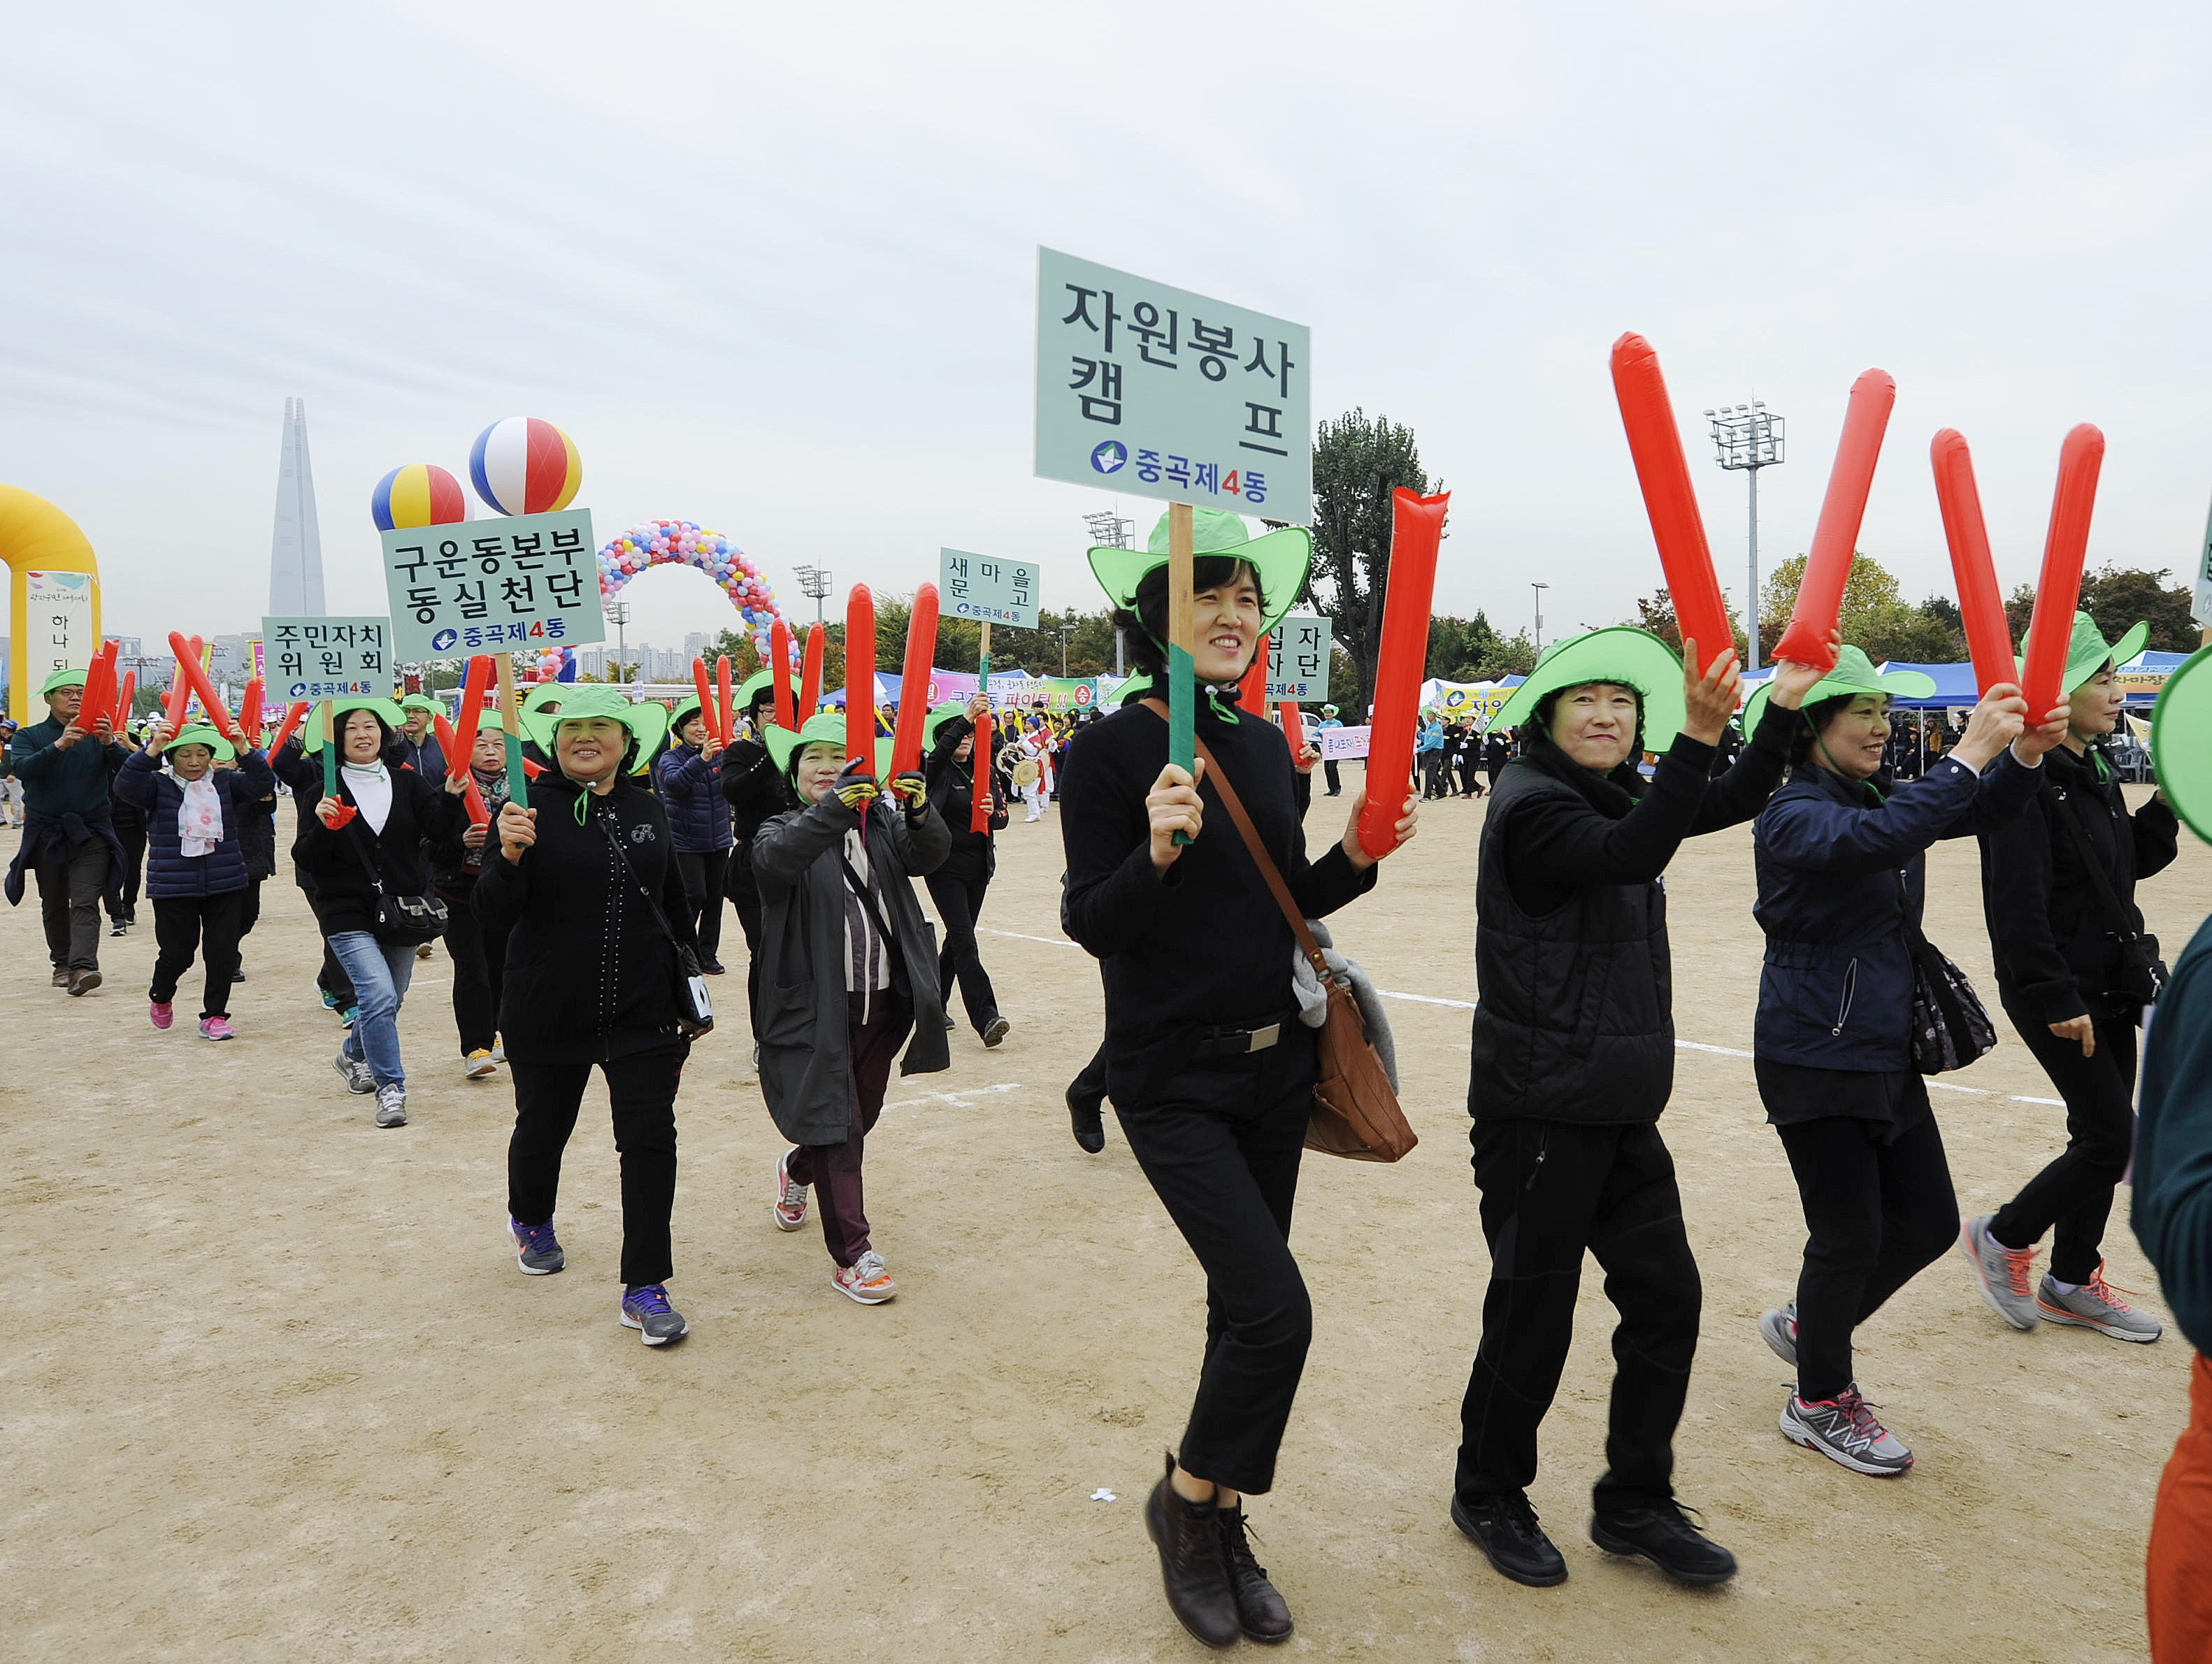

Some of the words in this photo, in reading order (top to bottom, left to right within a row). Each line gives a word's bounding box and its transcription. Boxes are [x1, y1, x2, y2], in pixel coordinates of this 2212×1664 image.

[1062, 283, 1294, 399] 자원봉사
[1135, 448, 1267, 503] 중곡제4동
[394, 528, 585, 583] 구운동본부
[972, 605, 1021, 622] 중곡제4동
[275, 624, 382, 650] 주민자치
[464, 617, 566, 647] 중곡제4동
[310, 681, 372, 696] 중곡제4동
